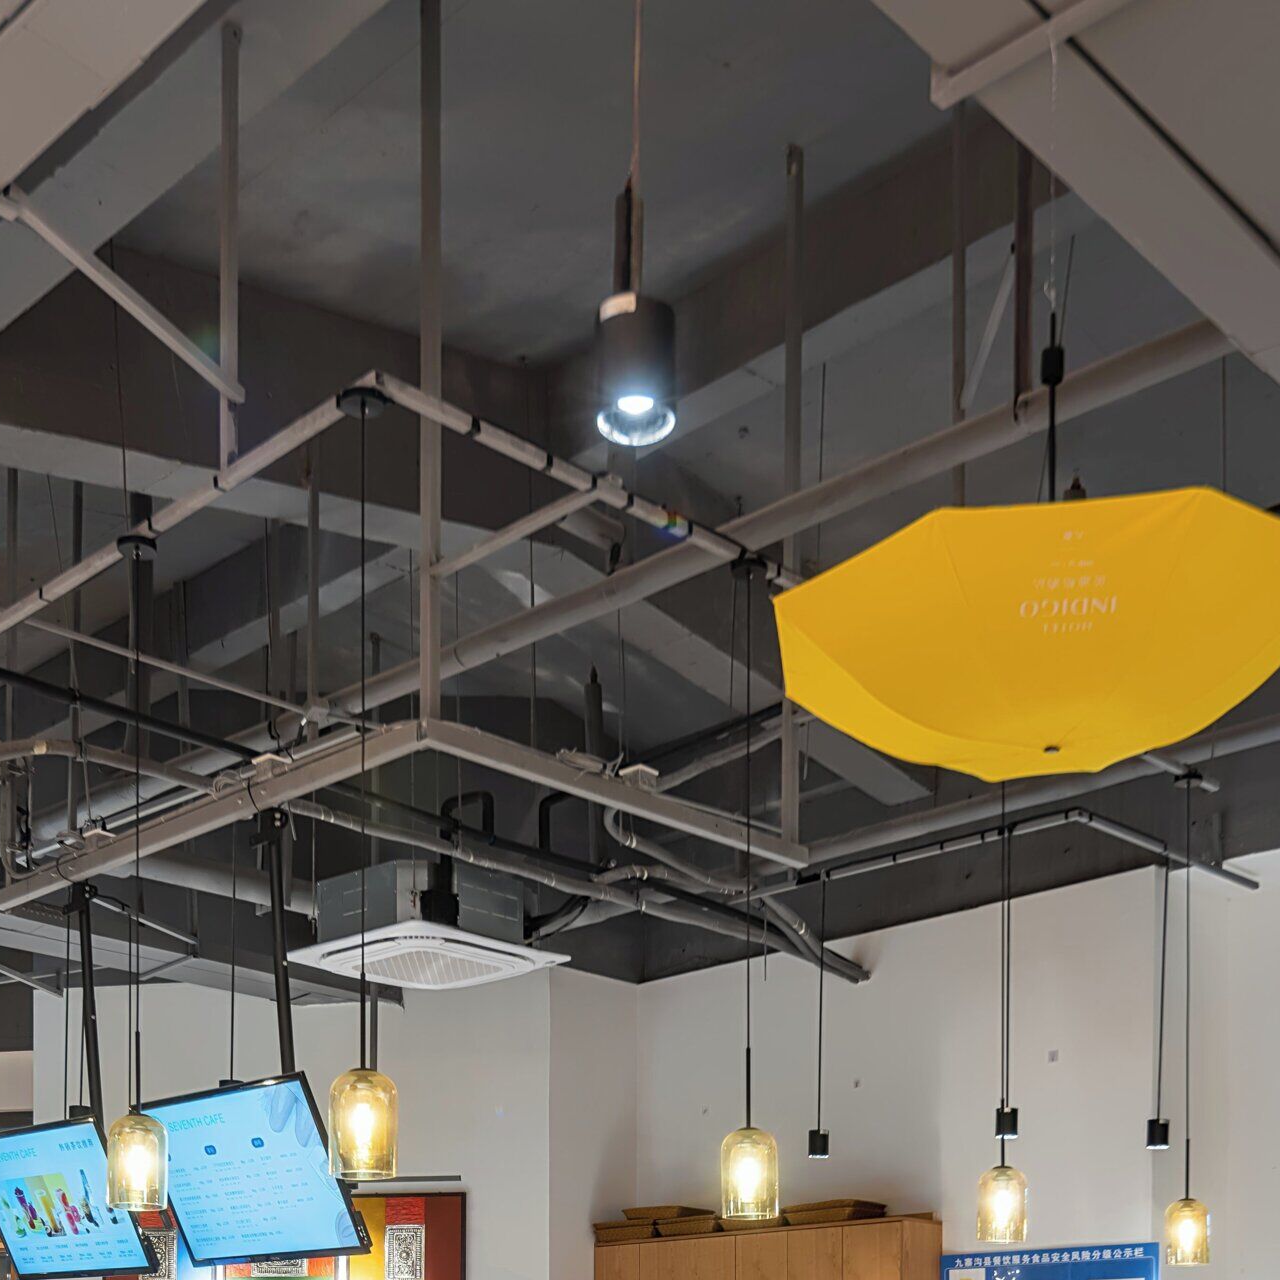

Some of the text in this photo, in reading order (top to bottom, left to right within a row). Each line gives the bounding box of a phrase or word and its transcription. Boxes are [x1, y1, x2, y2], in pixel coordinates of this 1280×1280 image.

[1019, 596, 1118, 620] INDIGO
[167, 1112, 226, 1132] SEVENTH CAFE
[20, 1147, 37, 1159] CAFE
